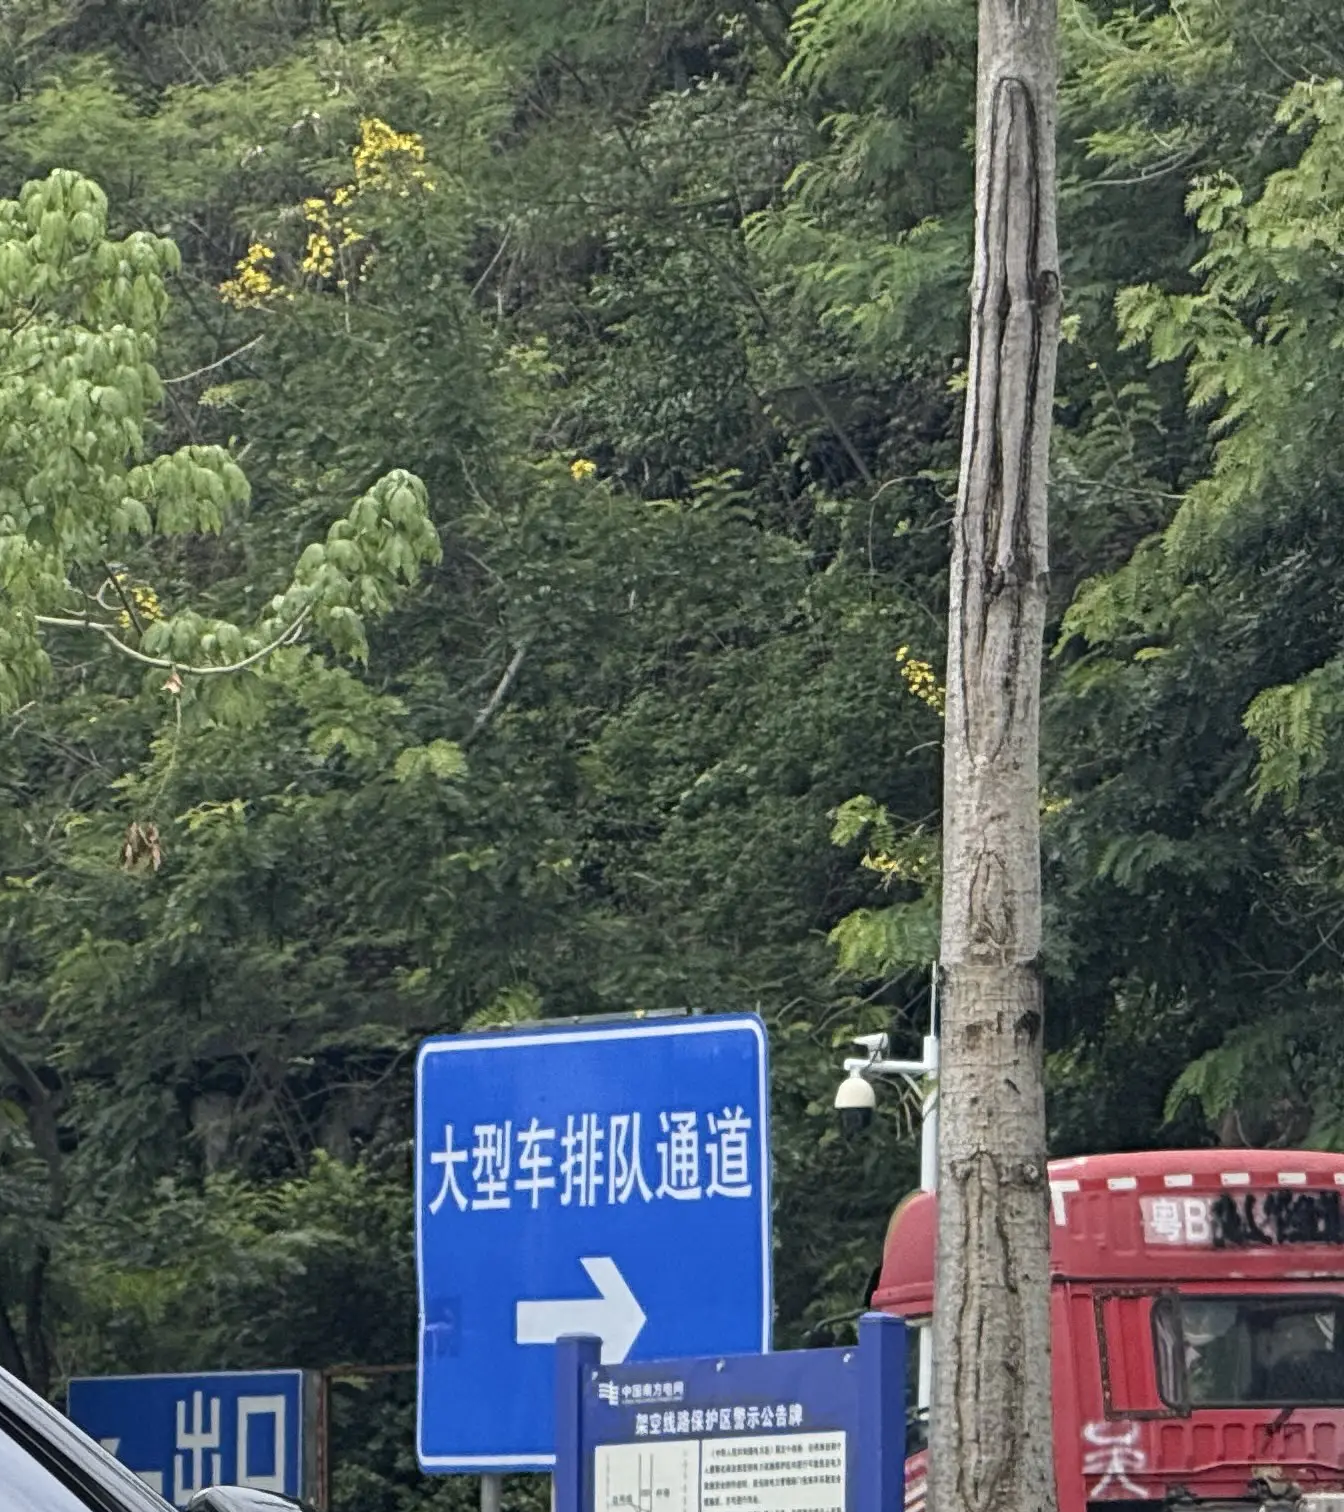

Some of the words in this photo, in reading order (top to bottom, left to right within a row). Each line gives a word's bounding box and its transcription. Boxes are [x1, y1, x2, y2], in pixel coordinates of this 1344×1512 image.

[428, 1106, 753, 1215] 大型车排队通道
[174, 1391, 285, 1506] 出口
[635, 1403, 802, 1435] 架空线路保护区警示公告牌
